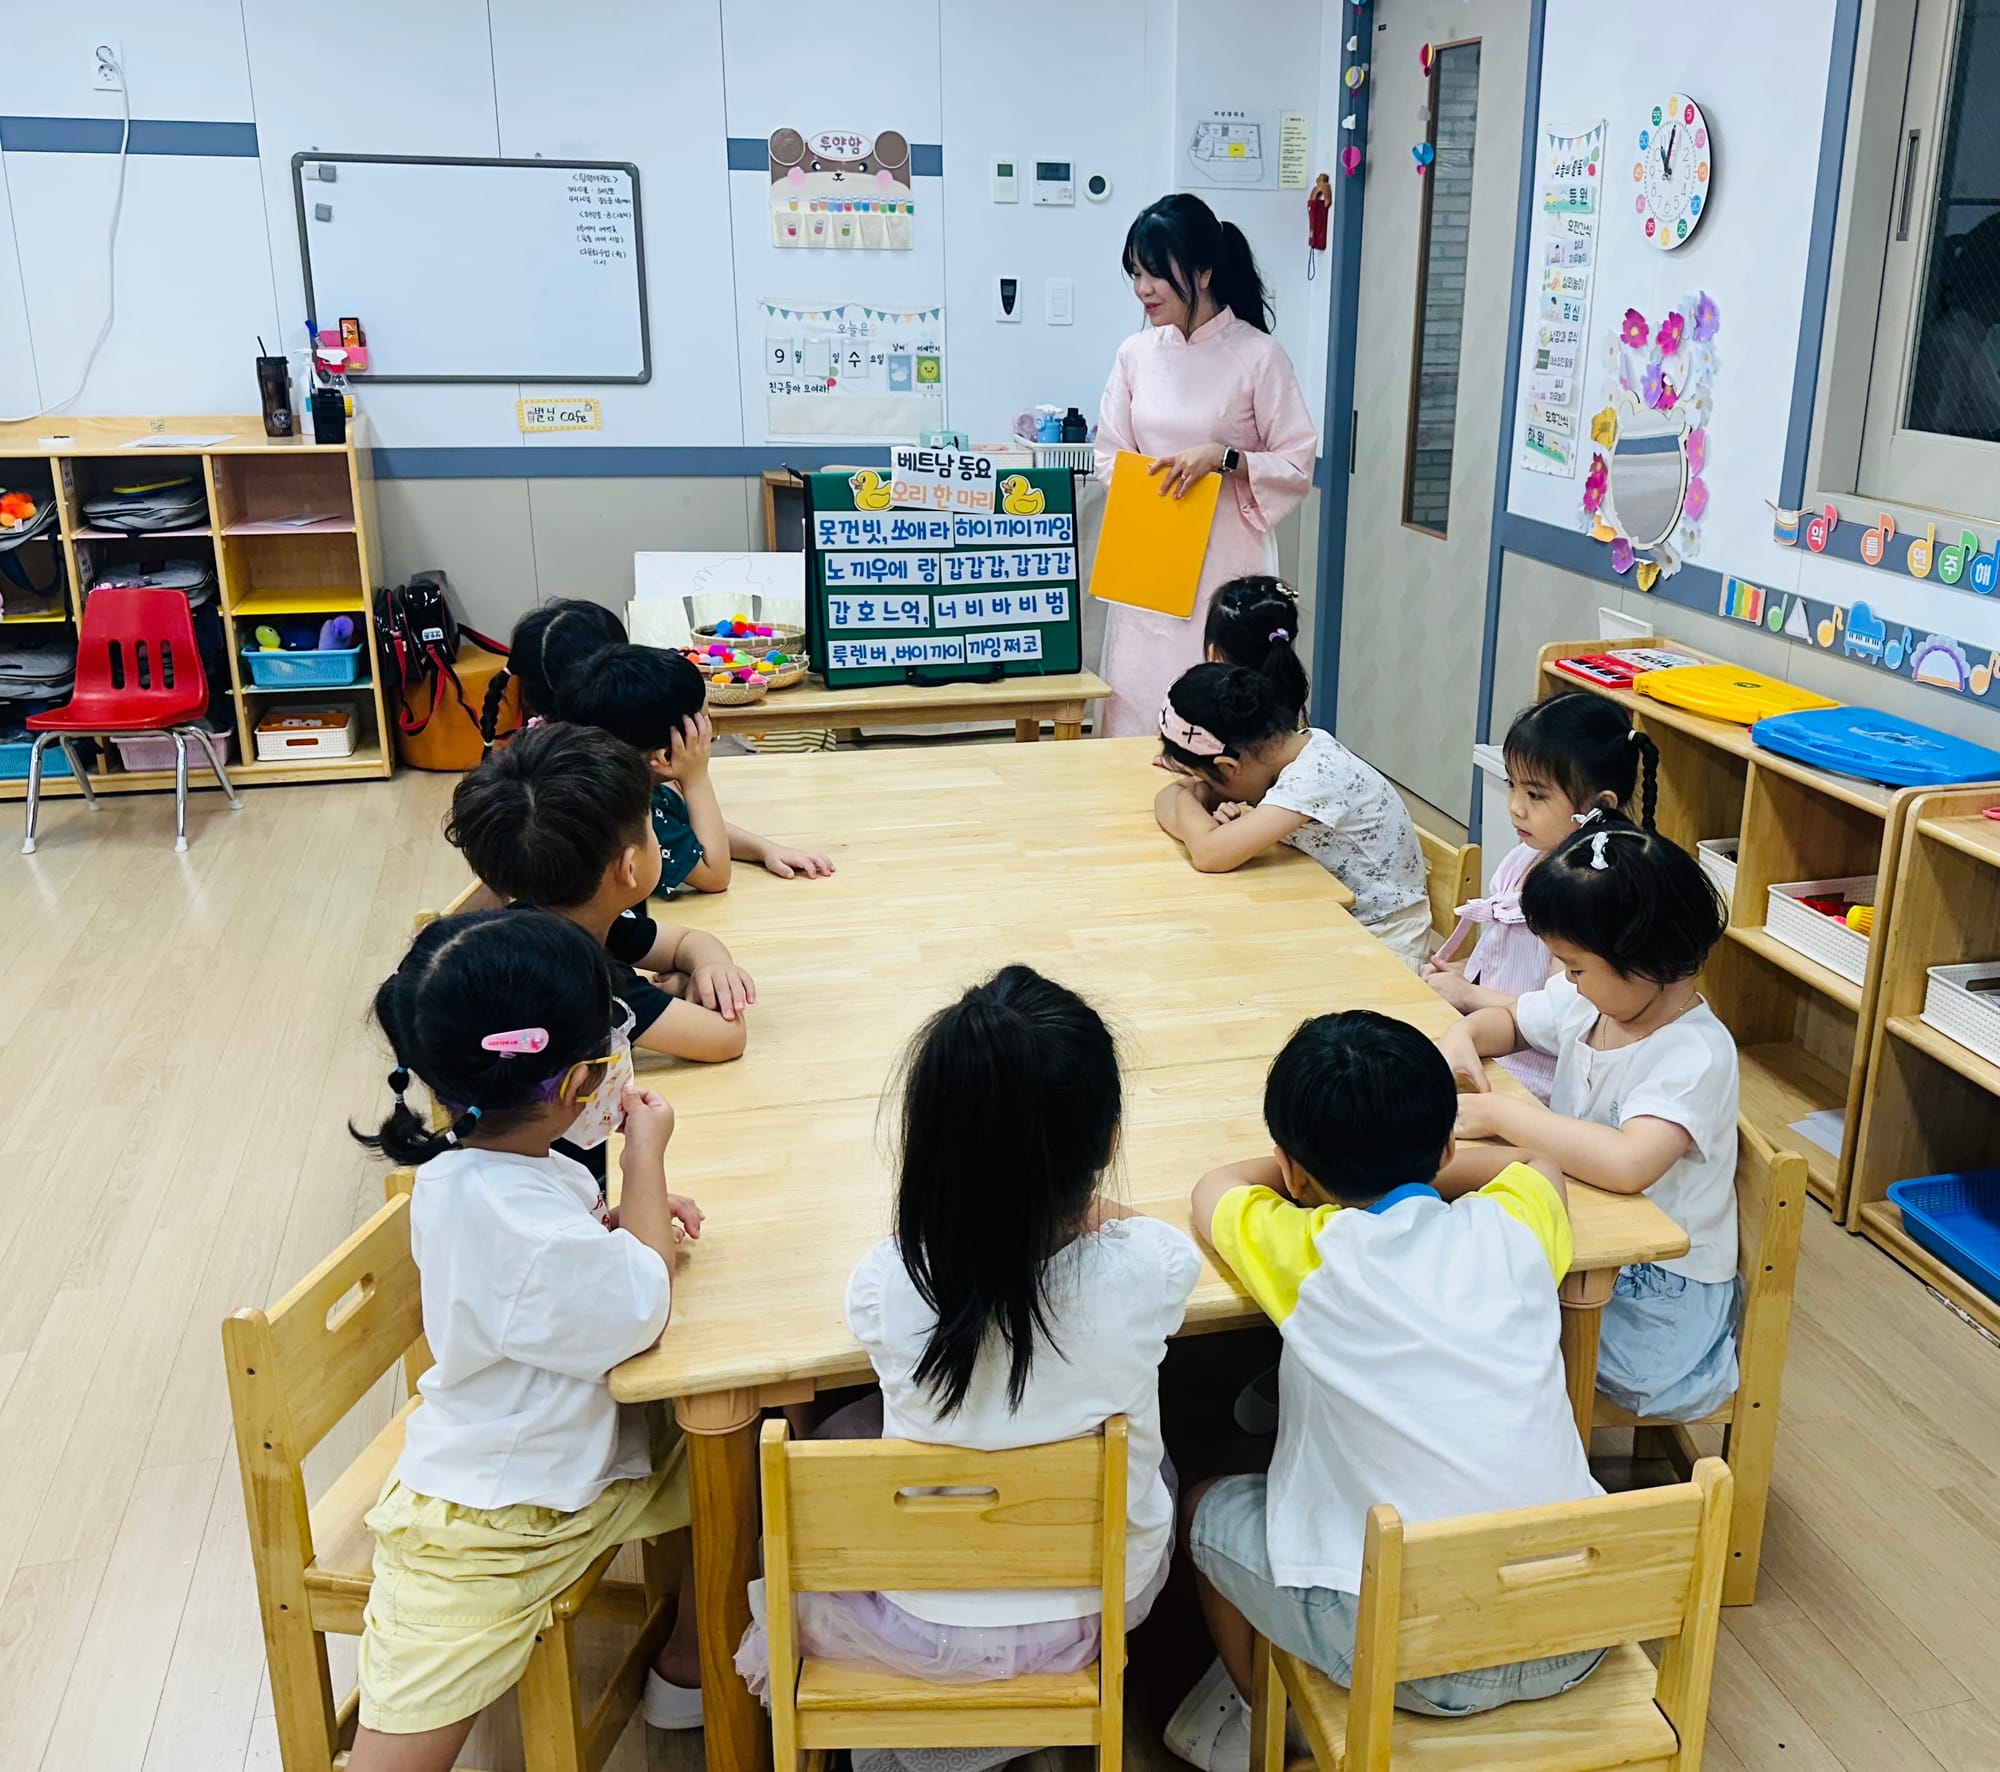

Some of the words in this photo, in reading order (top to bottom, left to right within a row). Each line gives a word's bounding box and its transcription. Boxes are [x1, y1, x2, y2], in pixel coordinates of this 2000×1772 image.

[820, 136, 862, 155] 투약함
[1554, 160, 1571, 177] 오늘의
[1569, 188, 1588, 205] 등원
[1567, 219, 1592, 238] 오전간식
[1563, 303, 1580, 321] 점심
[774, 348, 785, 363] 9
[795, 351, 802, 364] 월
[832, 353, 840, 364] 일
[848, 351, 861, 367] 수
[870, 355, 884, 365] 요일
[769, 382, 801, 395] 친구들아
[804, 384, 830, 395] 모여라!
[534, 407, 555, 423] 별님
[1546, 411, 1569, 428] 오후간식
[1527, 427, 1545, 448] 하원
[897, 452, 954, 479] 베트남
[958, 456, 992, 481] 동요
[892, 481, 927, 505] 오리
[933, 483, 952, 509] 한
[956, 490, 994, 511] 마리
[1811, 525, 1823, 545] 악
[1866, 536, 1878, 557] 를
[827, 558, 845, 580] 노
[917, 558, 937, 582] 랑
